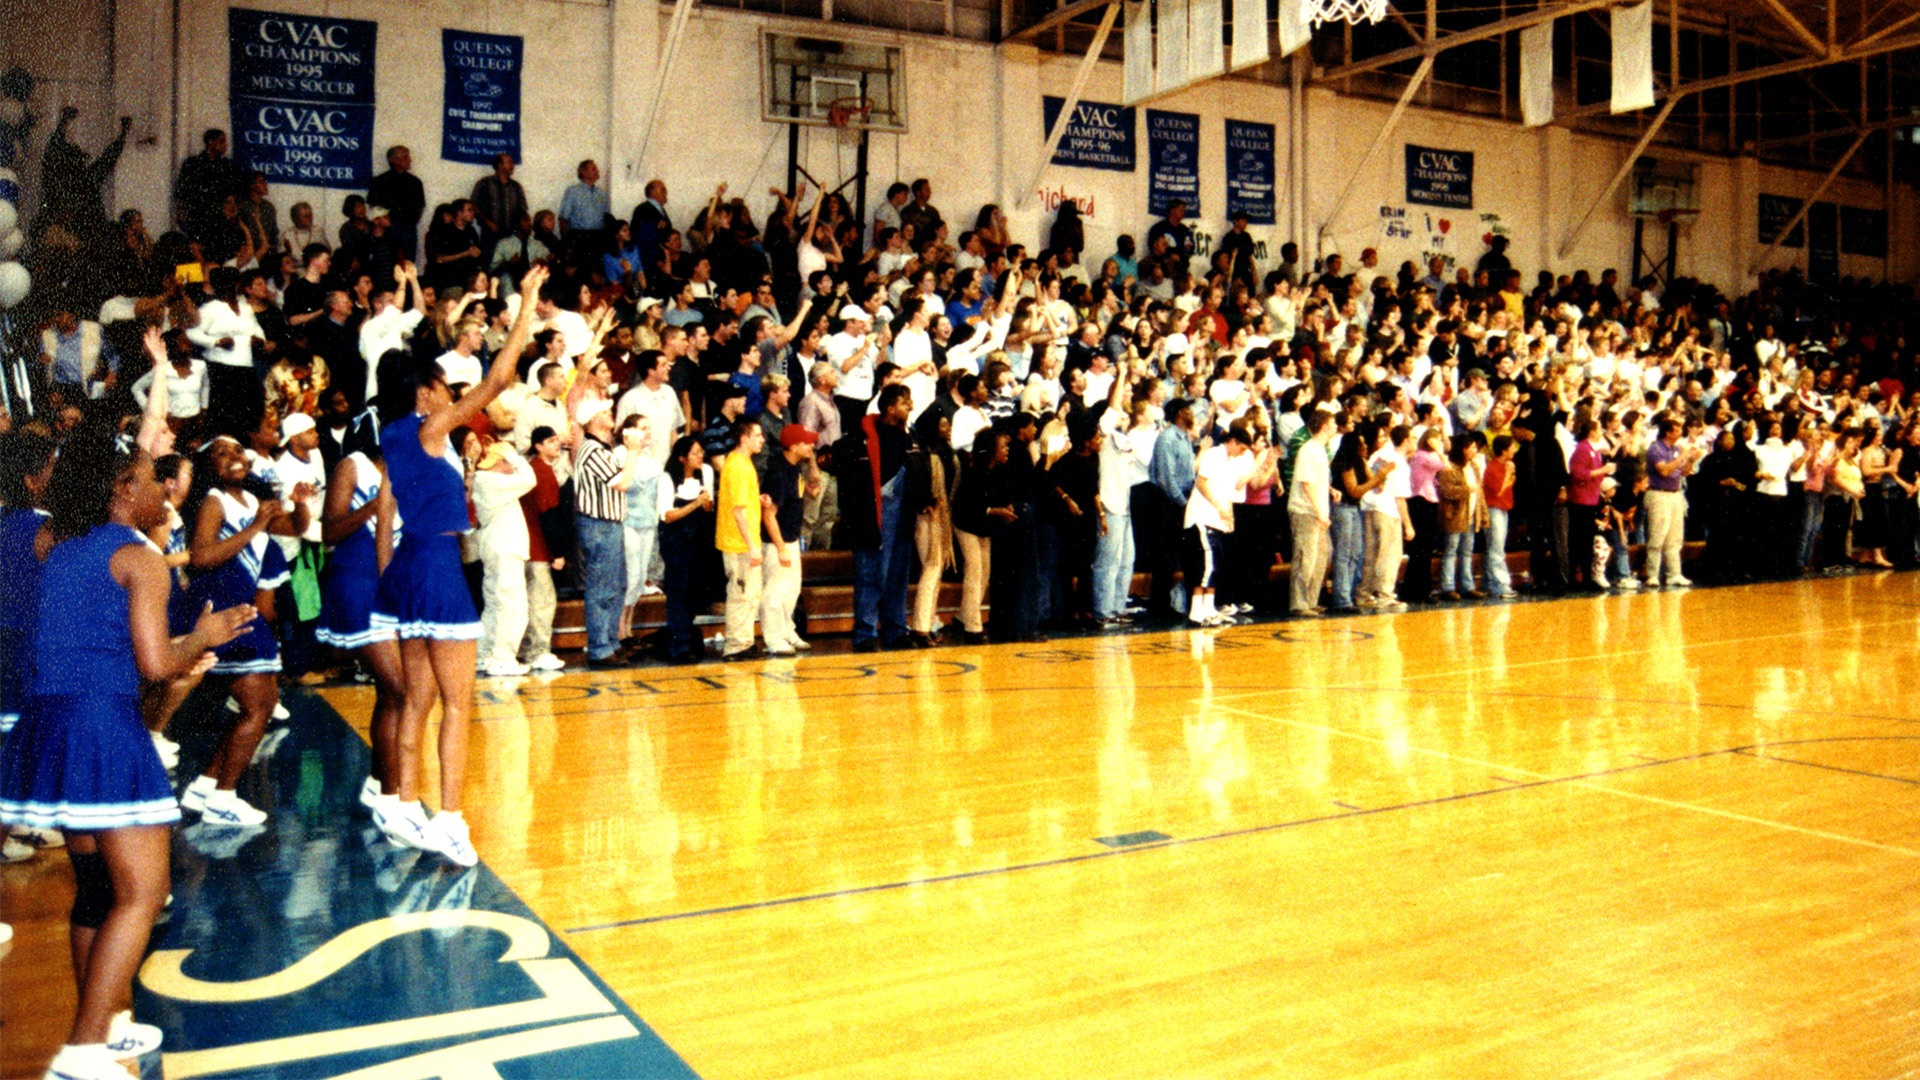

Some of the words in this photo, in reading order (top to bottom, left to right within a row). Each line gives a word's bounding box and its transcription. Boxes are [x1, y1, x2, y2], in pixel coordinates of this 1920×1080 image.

[259, 19, 349, 49] CVAC
[245, 43, 361, 66] CHAMPIONS
[453, 39, 512, 56] QUEENS
[451, 53, 515, 71] COLLEGE
[286, 63, 323, 79] 1995
[251, 75, 296, 91] MEN'S
[301, 79, 356, 95] SOCCER
[258, 106, 347, 134] CVAC
[1067, 105, 1118, 128] VAC
[1153, 117, 1193, 130] QUEENS
[244, 129, 360, 150] CHAMPIONS
[1065, 125, 1126, 142] HAMPIONS
[1151, 129, 1195, 142] COLLEGE
[1231, 126, 1269, 139] QUEENS
[1070, 138, 1112, 153] 1995-96
[1230, 138, 1271, 151] COLLEGE
[284, 148, 323, 164] 1996
[1055, 149, 1076, 160] EN'S
[1078, 151, 1131, 165] BASKETBALL
[1419, 151, 1461, 171] CVAC
[251, 161, 295, 177] MEN'S
[300, 166, 354, 180] SOCCER
[1413, 167, 1468, 183] CHAMPIONS
